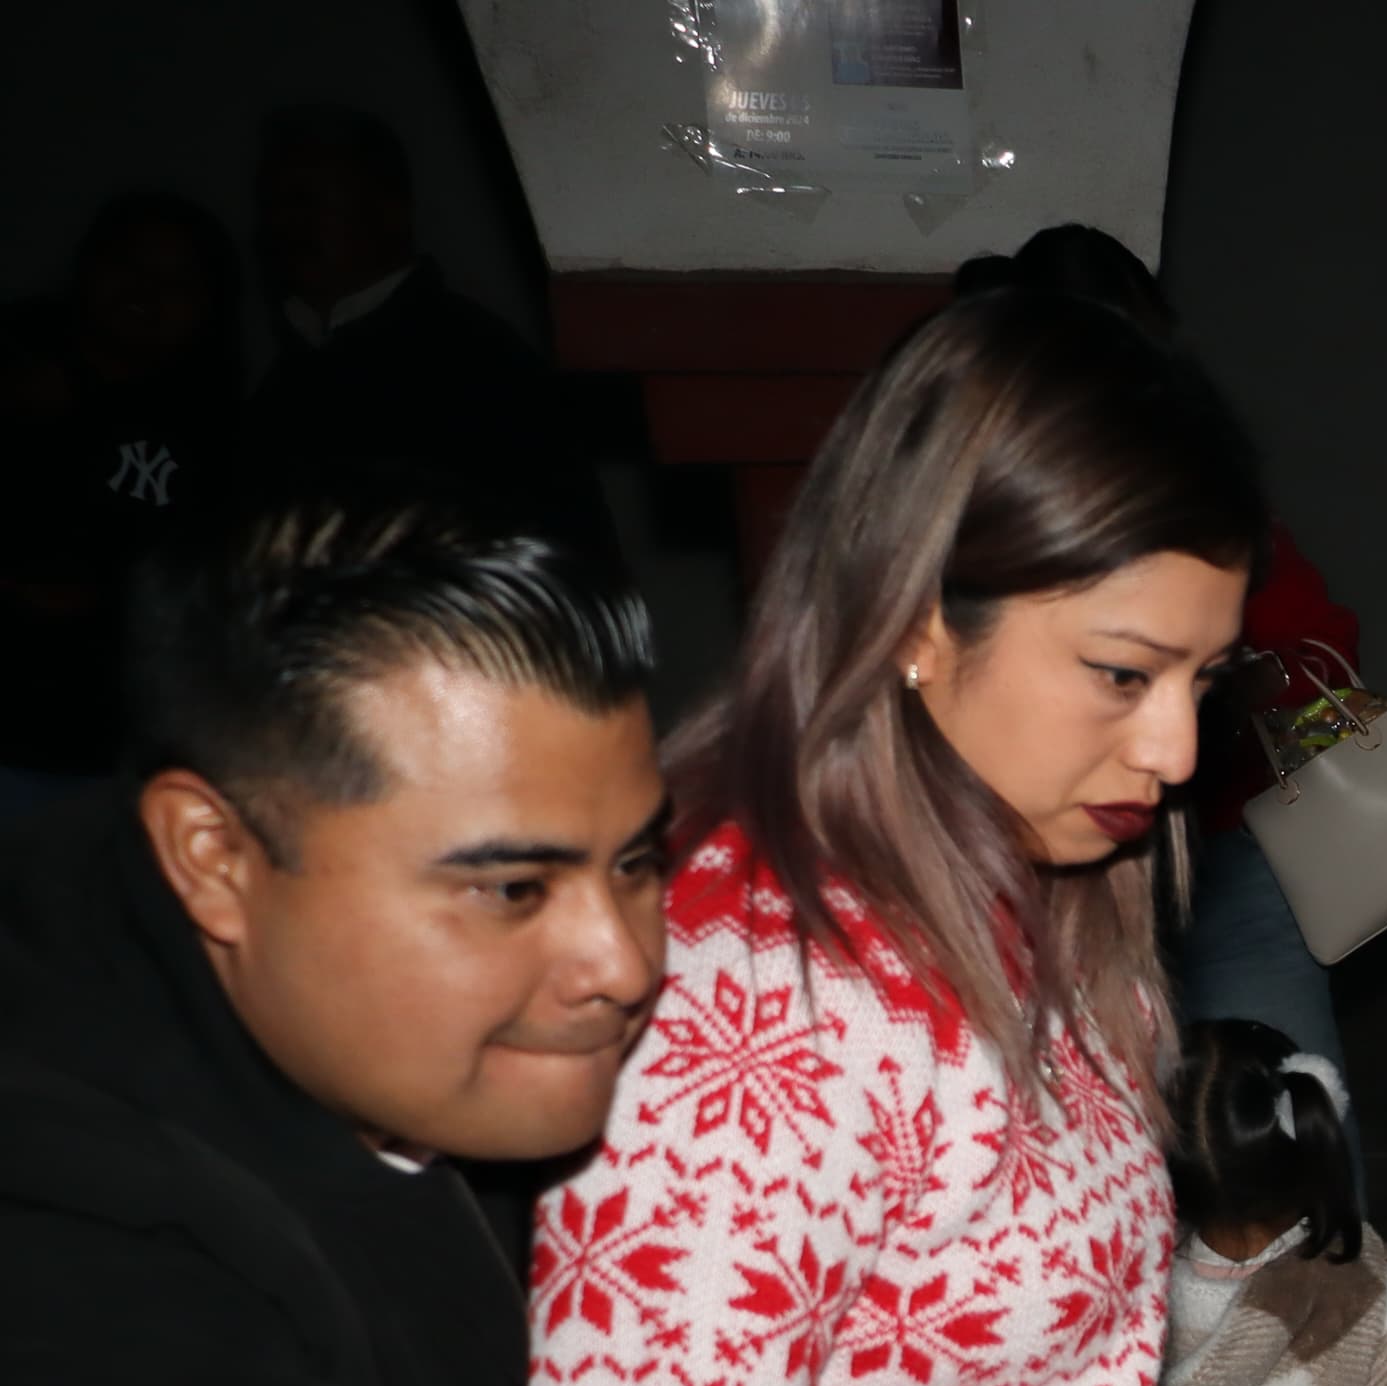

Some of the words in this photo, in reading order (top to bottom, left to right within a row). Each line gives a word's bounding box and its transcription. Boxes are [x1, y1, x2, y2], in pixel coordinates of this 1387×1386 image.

[728, 91, 787, 110] JUEVES
[738, 112, 785, 124] diciembre
[766, 130, 791, 143] 9:00
[106, 440, 178, 506] NY
